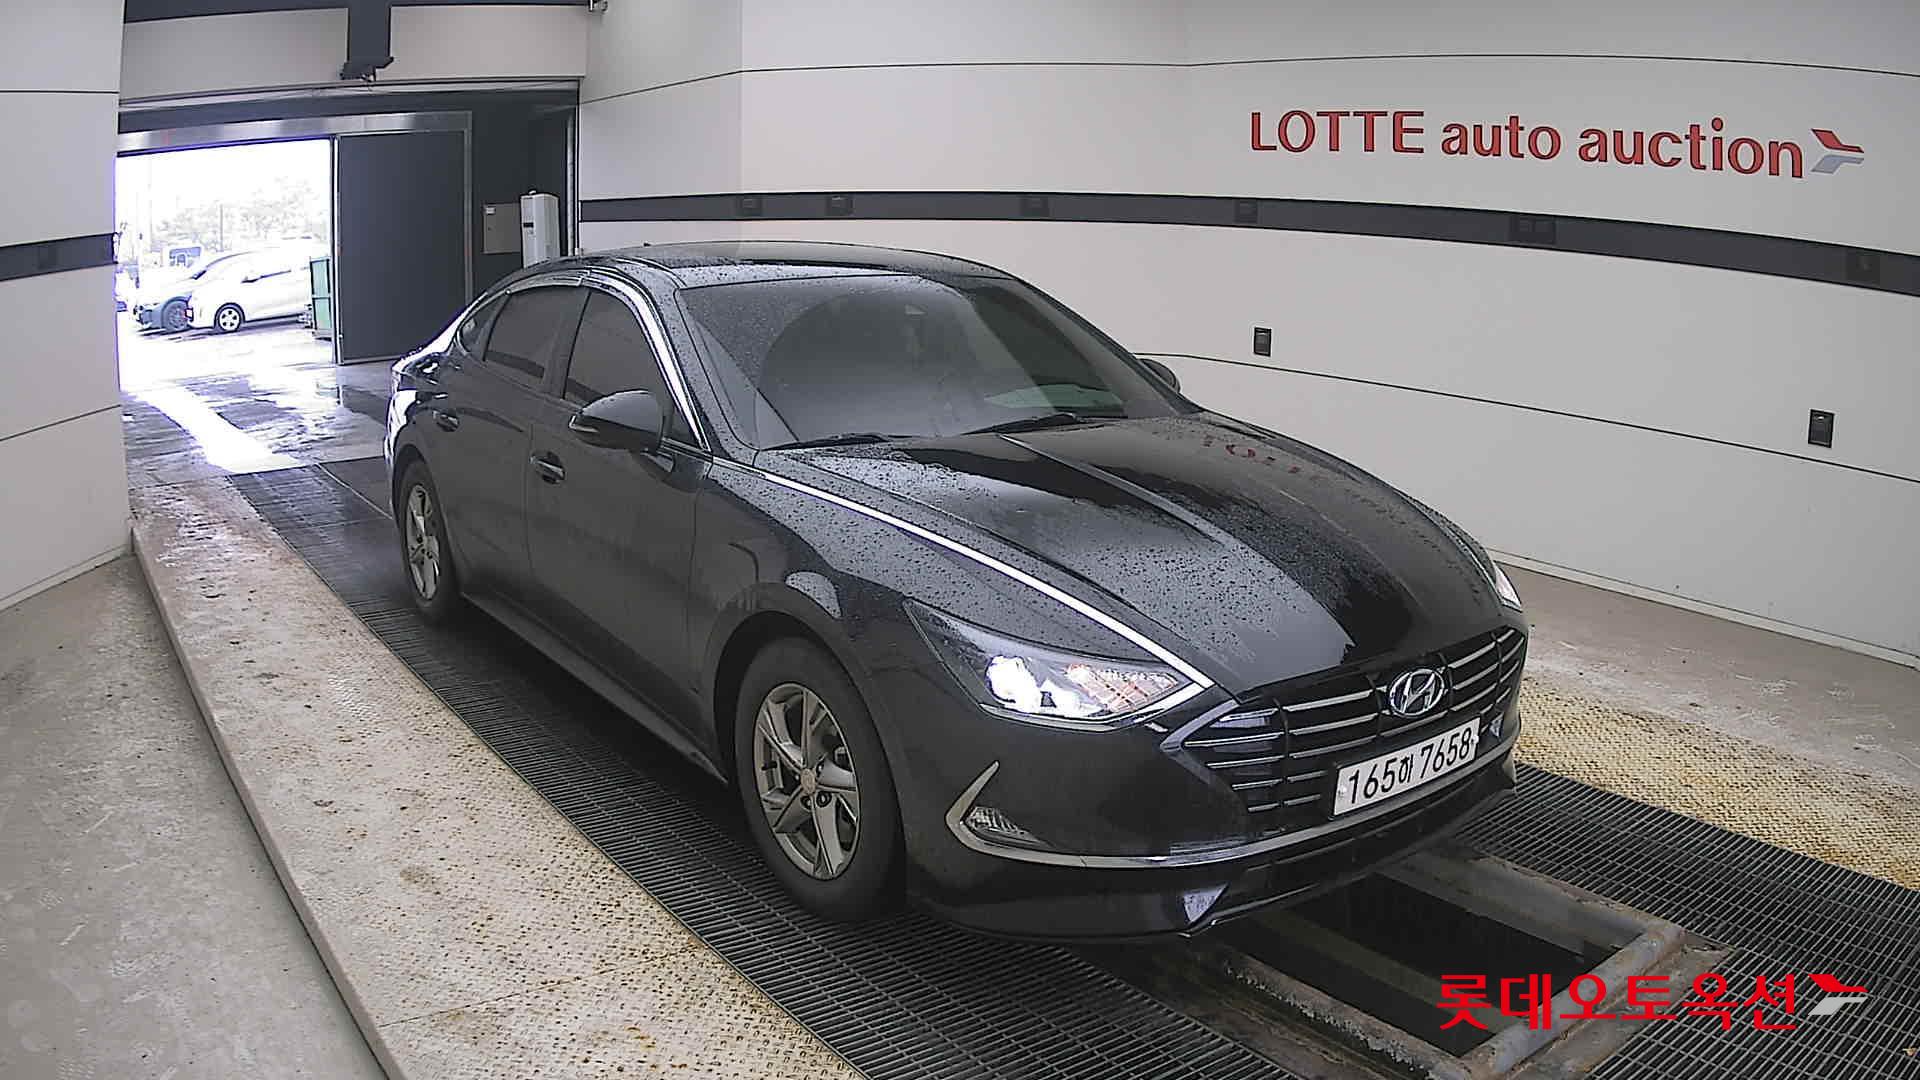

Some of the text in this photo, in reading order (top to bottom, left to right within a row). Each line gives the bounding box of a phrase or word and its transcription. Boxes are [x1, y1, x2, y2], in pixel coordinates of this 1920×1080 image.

[1251, 110, 1804, 179] LOTTE auto auction
[1420, 727, 1473, 779] 7658
